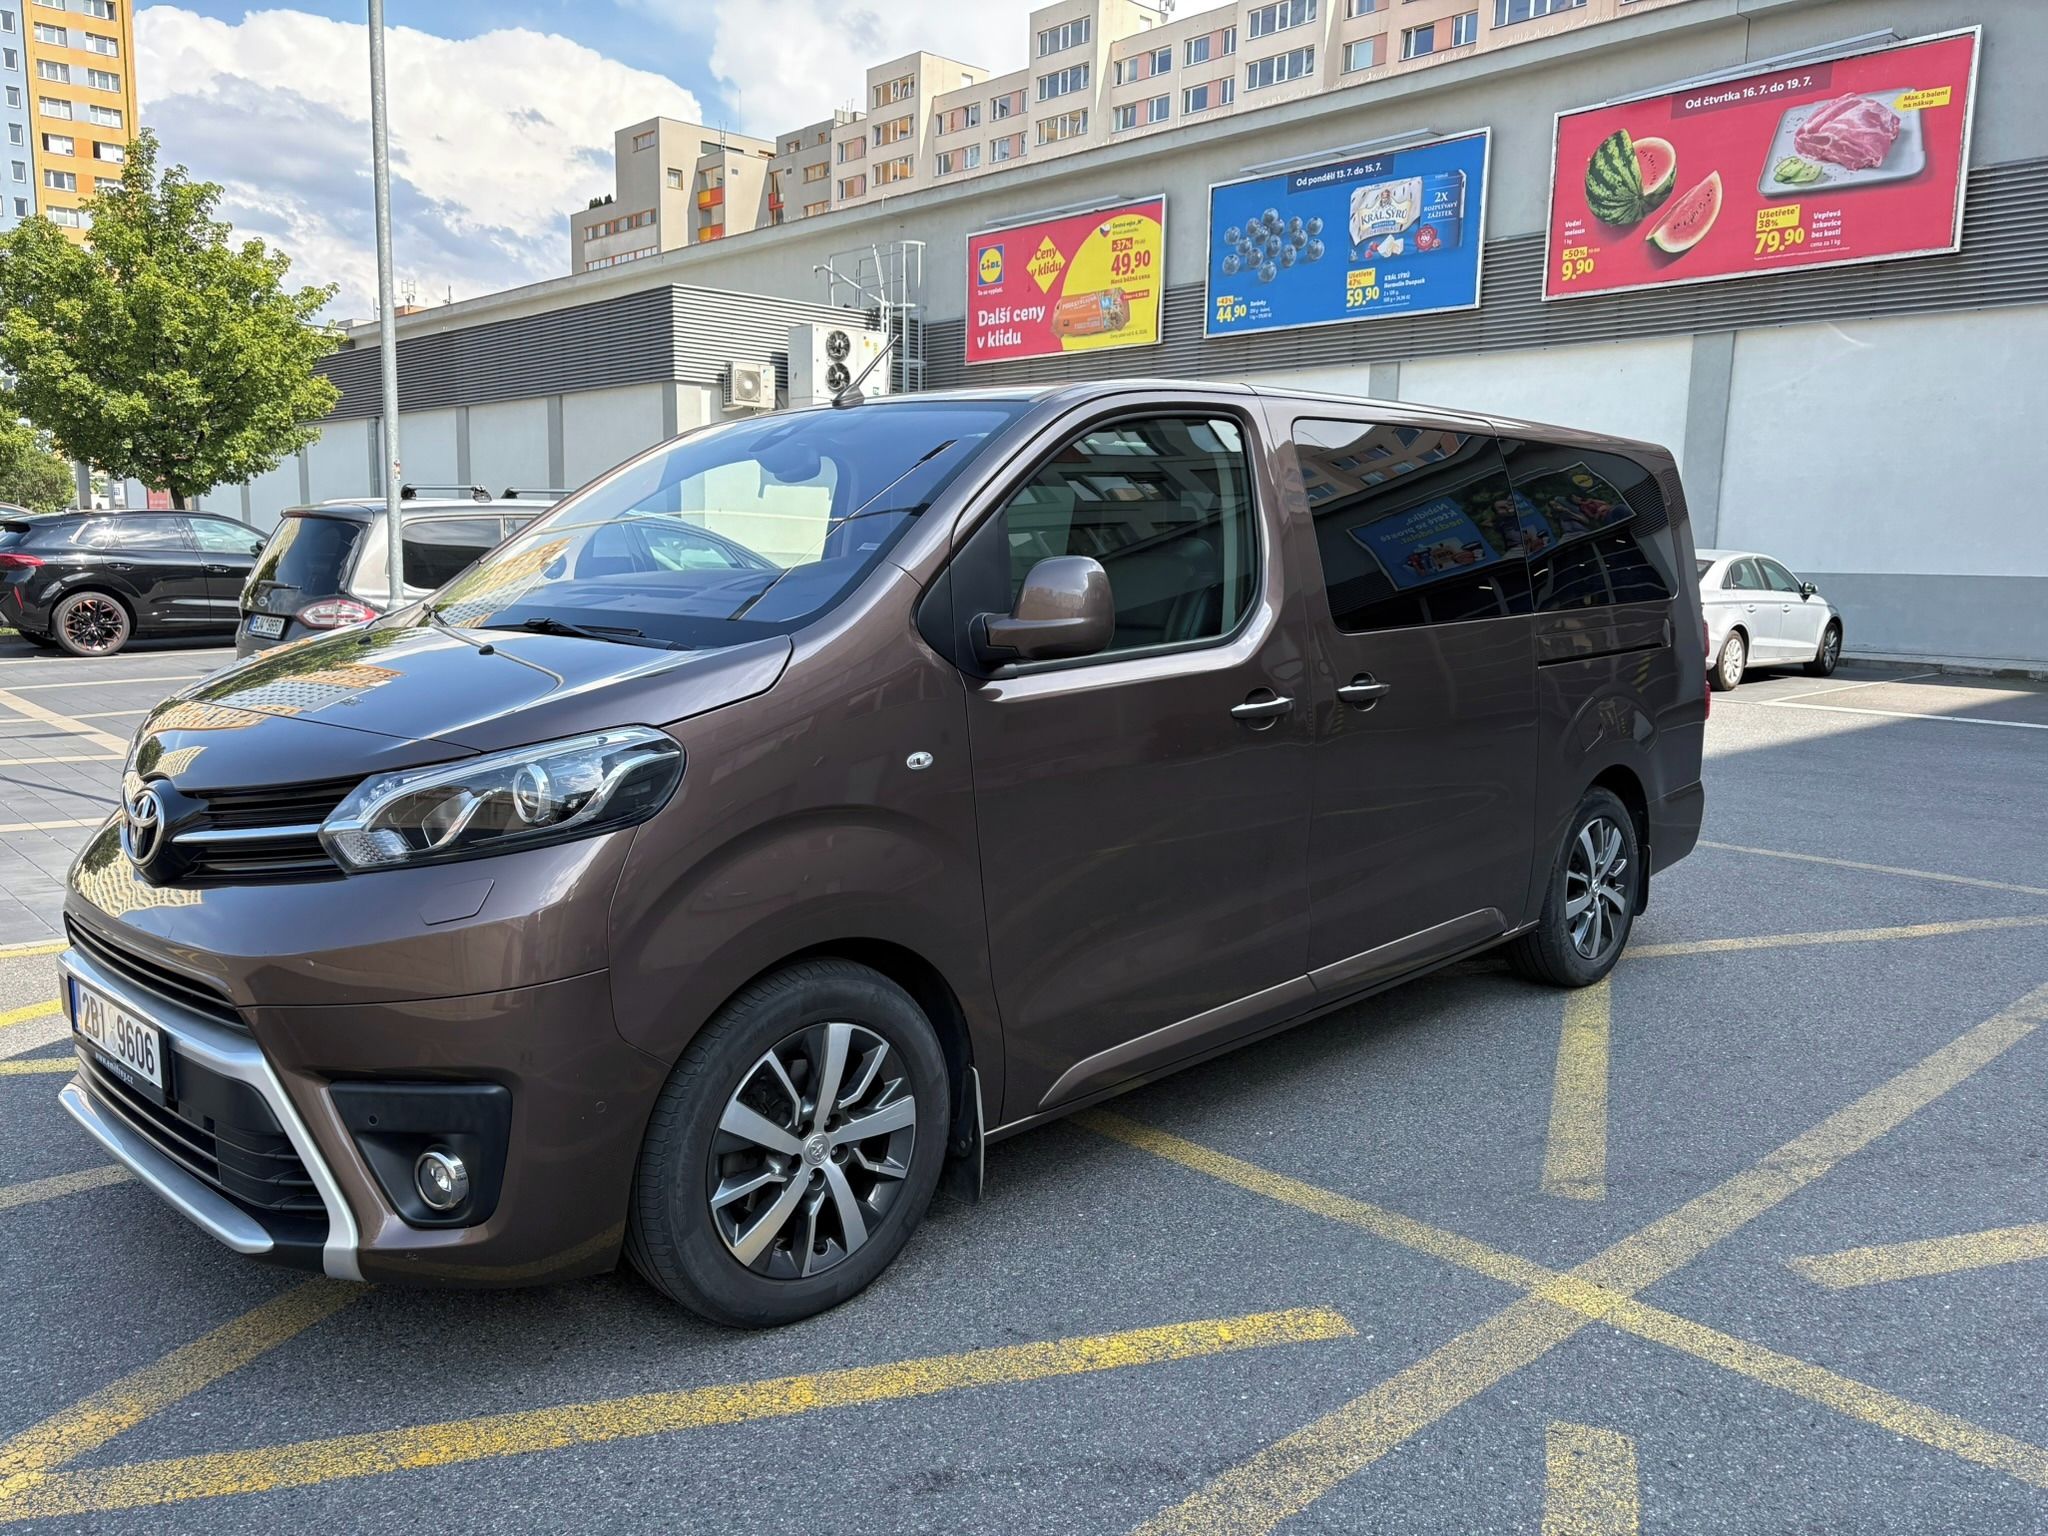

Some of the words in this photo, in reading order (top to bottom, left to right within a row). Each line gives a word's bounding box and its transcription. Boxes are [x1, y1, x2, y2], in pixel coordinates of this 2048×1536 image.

[1685, 98, 1701, 109] Od
[1703, 91, 1740, 106] čtvrtka
[1743, 87, 1757, 98] 16.
[1759, 85, 1768, 95] 7.
[1770, 82, 1784, 93] do
[1786, 79, 1801, 90] 19.
[1803, 76, 1812, 86] 7.
[1296, 178, 1307, 187] Od
[1308, 171, 1335, 186] pondělí
[1337, 170, 1346, 178] 13.
[1347, 168, 1353, 176] 7.
[1354, 166, 1364, 175] do
[1365, 164, 1375, 173] 15.
[1375, 162, 1382, 170] 7.
[1361, 211, 1386, 225] KRÁL
[1565, 219, 1582, 228] Vodní
[1758, 219, 1778, 229] 38%
[1813, 209, 1841, 220] Vepřová
[1754, 227, 1805, 255] 79.90
[1824, 227, 1841, 237] kostí
[1035, 247, 1058, 261] Ceny
[1111, 250, 1151, 276] 49.90
[1565, 249, 1585, 257] -50%
[1031, 268, 1037, 277] v
[1037, 260, 1062, 277] klidu
[1561, 258, 1595, 281] 9.90
[1346, 286, 1380, 308] 59.90
[977, 306, 1012, 327] Další
[1013, 305, 1046, 323] ceny
[1216, 304, 1247, 323] 44.90
[977, 336, 985, 349] v
[987, 328, 1022, 348] klidu
[117, 1014, 154, 1075] 9606
